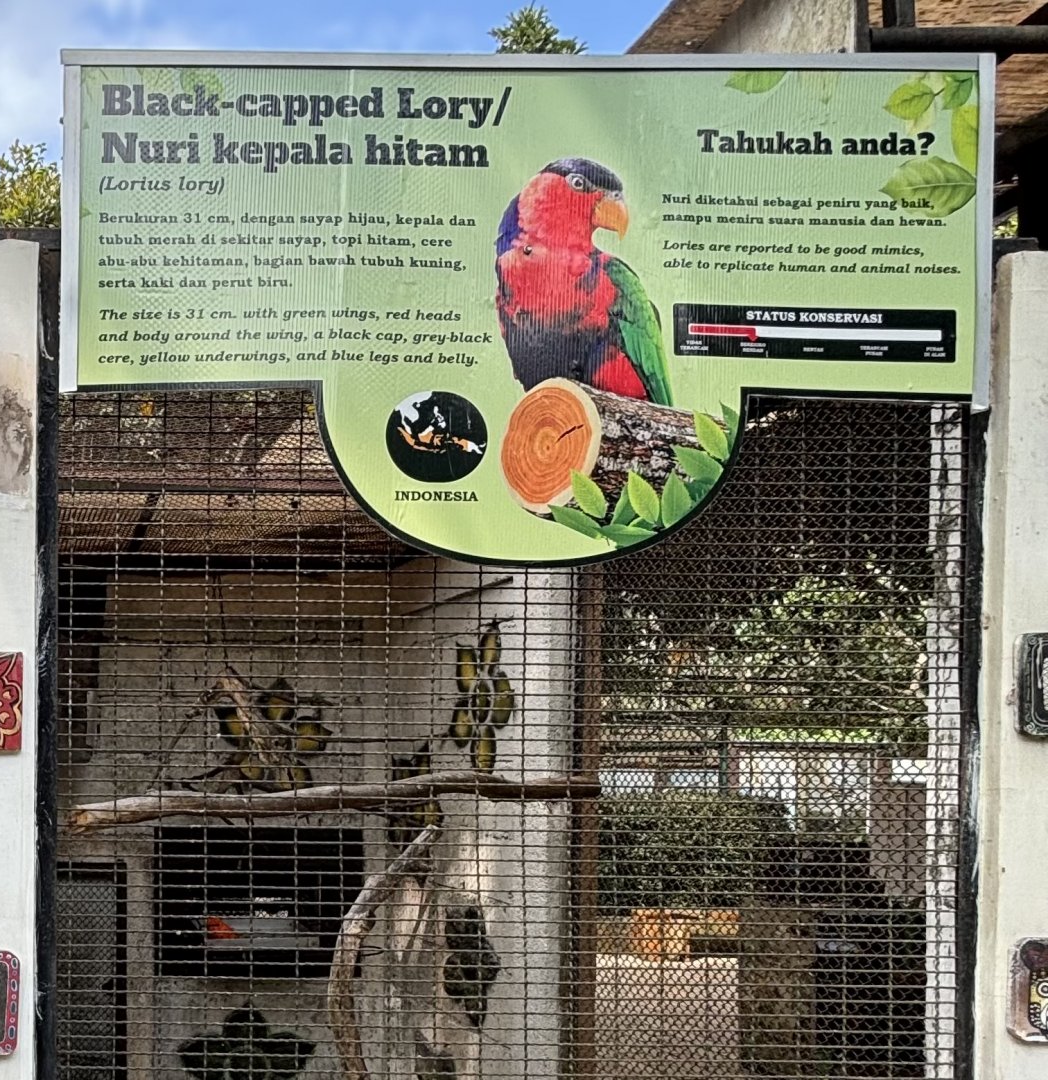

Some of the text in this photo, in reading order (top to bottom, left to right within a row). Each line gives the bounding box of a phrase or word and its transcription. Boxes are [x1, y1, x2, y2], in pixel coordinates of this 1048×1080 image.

[101, 84, 512, 129] Black-capped Lory/
[697, 129, 935, 155] Tahukah anda?
[101, 132, 489, 173] Nuri kepala hitam
[98, 174, 224, 195] (Lorius lory)
[662, 240, 924, 257] Lories are reported to be good mimics,
[663, 257, 960, 274] able to replicate human and animal noises.
[98, 277, 136, 288] serta
[178, 276, 206, 287] dan
[212, 277, 252, 290] perut
[257, 276, 292, 287] biru.
[99, 308, 127, 320] The
[131, 306, 162, 320] size
[167, 308, 180, 319] is
[185, 308, 203, 319] 31
[243, 307, 277, 318] with
[282, 310, 326, 321] green
[331, 306, 379, 321] wings,
[385, 308, 410, 320] red
[415, 309, 461, 321] heads
[746, 310, 882, 323] STATUS KONSERVASI
[98, 328, 492, 345] and body around the wing, a black cap, grey-black
[97, 349, 478, 367] cere, yellow underwings, and blue legs and belly.
[394, 490, 478, 501] INDONESIA
